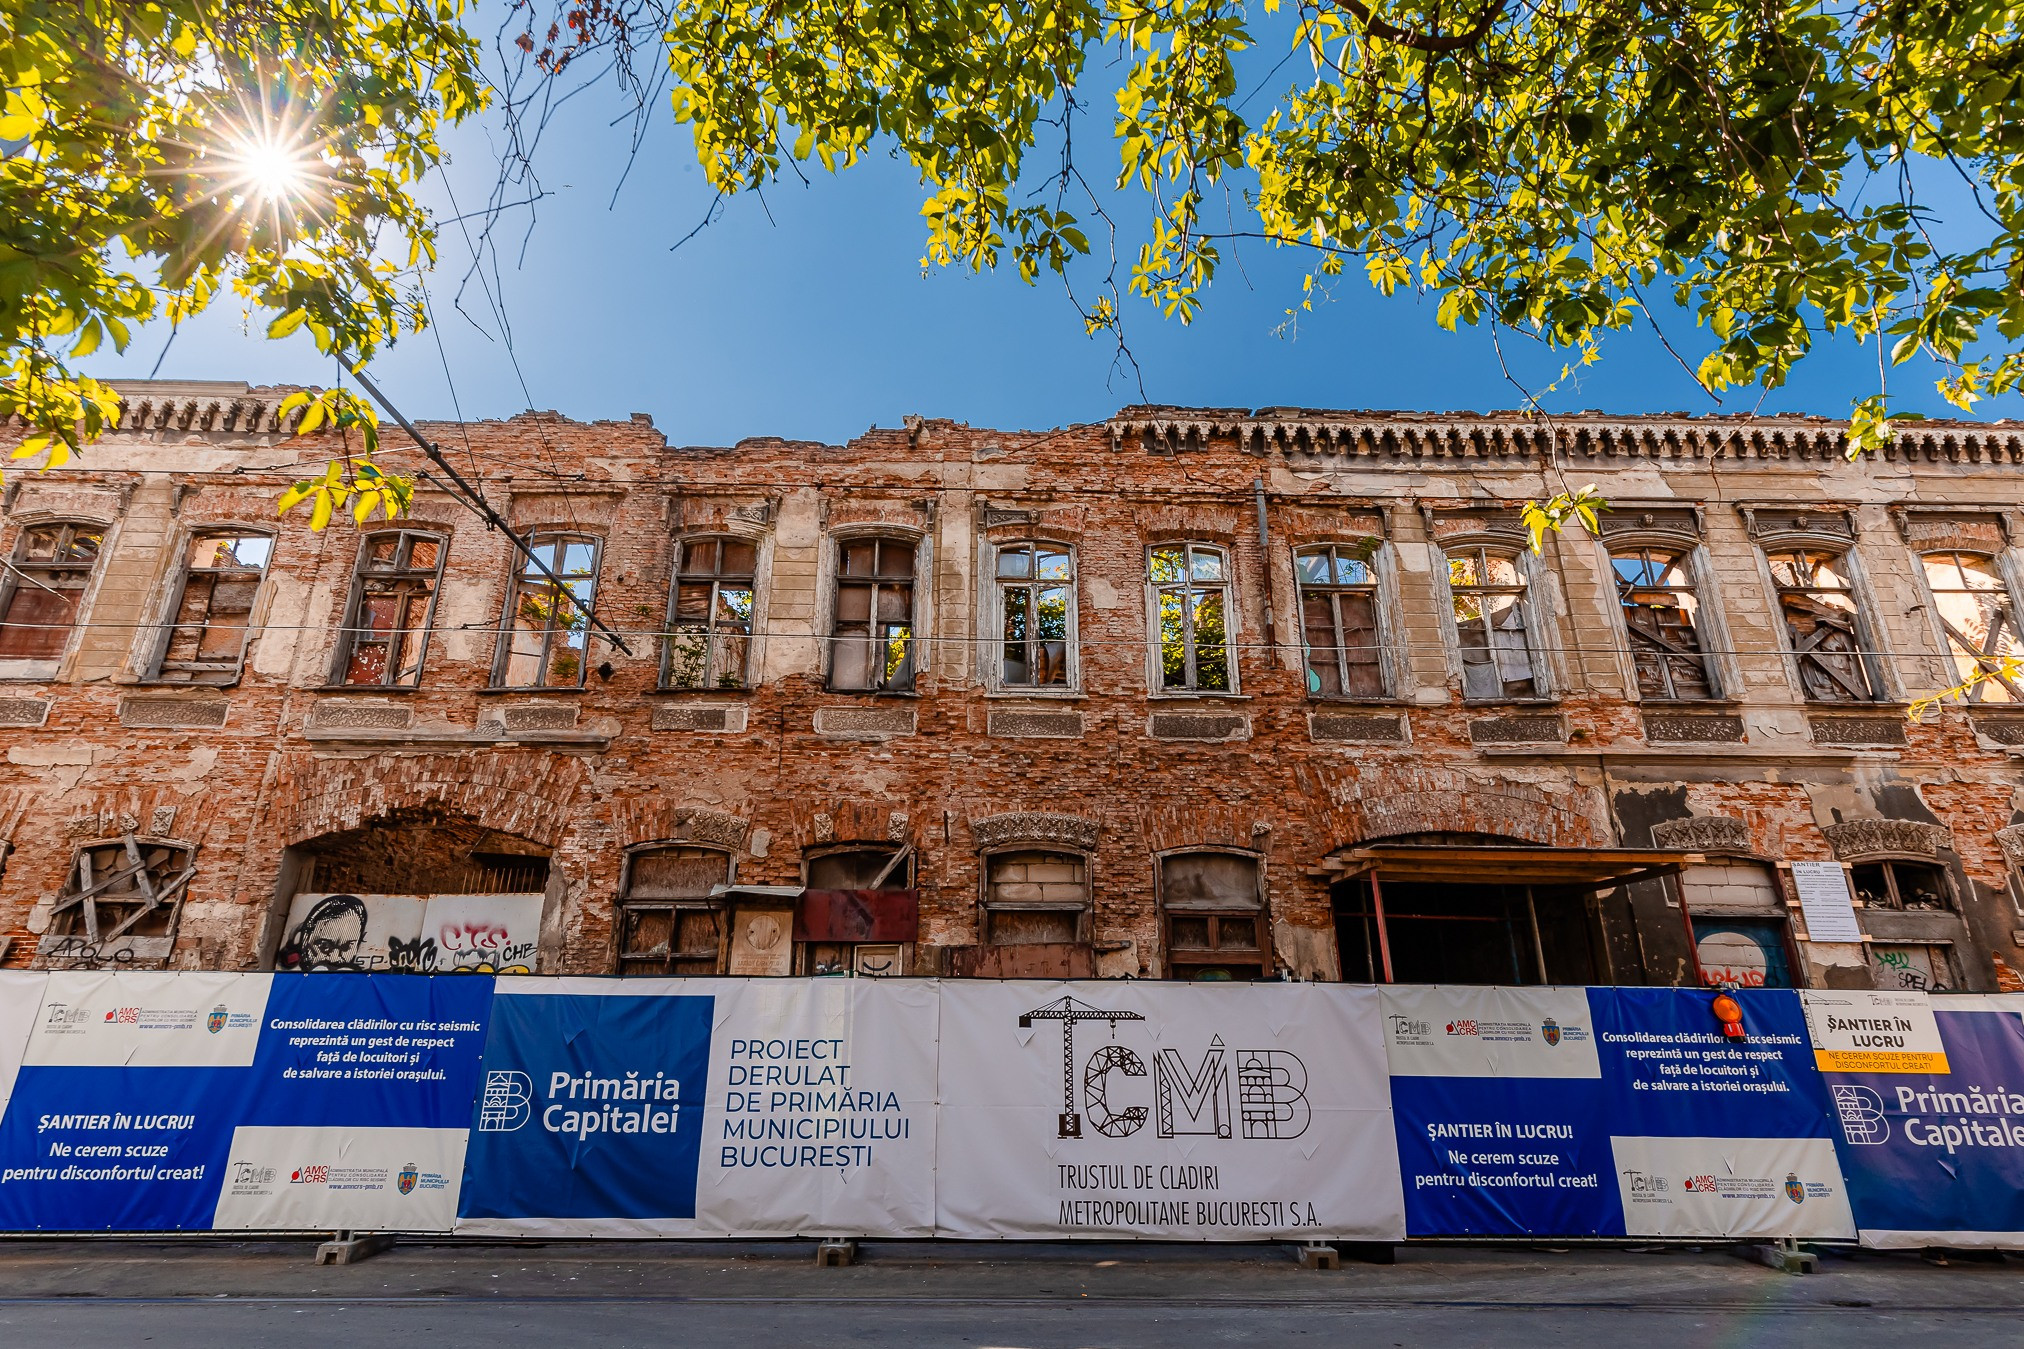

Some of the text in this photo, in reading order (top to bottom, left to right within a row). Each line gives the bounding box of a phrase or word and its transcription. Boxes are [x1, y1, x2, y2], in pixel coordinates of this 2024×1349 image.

[118, 1007, 139, 1016] AMC
[118, 1016, 137, 1024] CRS
[270, 1019, 480, 1031] Consolidarea clădirilor cu risc seismic
[1893, 1016, 1912, 1031] ÎN
[289, 1034, 454, 1049] reprezintă un gest de respect
[1602, 1032, 1672, 1043] Consolidarea
[1675, 1032, 1724, 1044] clădirilor
[1743, 1034, 1761, 1044] isc
[1762, 1034, 1802, 1044] seismic
[1852, 1035, 1904, 1047] LUCRU
[731, 1040, 843, 1059] PROIECT
[1626, 1048, 1783, 1062] reprezintă un gest de respect
[317, 1051, 419, 1065] față de locuitori și
[1836, 1061, 1900, 1069] DISCONFORTUL
[283, 1068, 446, 1082] de salvare a istoriei orașului.
[1019, 996, 1310, 1139] TCMB
[1659, 1064, 1759, 1078] față de locuitori și
[728, 1066, 850, 1086] DERULAT
[548, 1071, 680, 1100] Primăria
[1633, 1079, 1790, 1094] de salvare a istoriei orașului.
[726, 1087, 901, 1112] DE PRIMĂRIA
[1895, 1085, 2024, 1114] Primăria
[38, 1112, 194, 1134] ȘANTIER ÎN LUCRU!
[543, 1104, 680, 1141] Capitalei
[723, 1118, 909, 1139] MUNICIPIULUI
[1427, 1122, 1573, 1141] ȘANTIER ÎN LUCRU!
[50, 1143, 168, 1157] Ne cerem scuze
[1448, 1150, 1559, 1165] Ne cerem scuze
[720, 1146, 872, 1174] BUCUREȘTI
[2, 1165, 205, 1183] pentru disconfortul creat!
[304, 1165, 328, 1174] AMC
[1058, 1164, 1219, 1190] TRUSTUL DE CLADIRI
[305, 1175, 327, 1183] CRS
[1416, 1172, 1598, 1189] pentru disconfortul creat!
[1699, 1184, 1716, 1192] CRS
[1059, 1200, 1322, 1227] METROPOLITANE BUCURESTI S.A.
